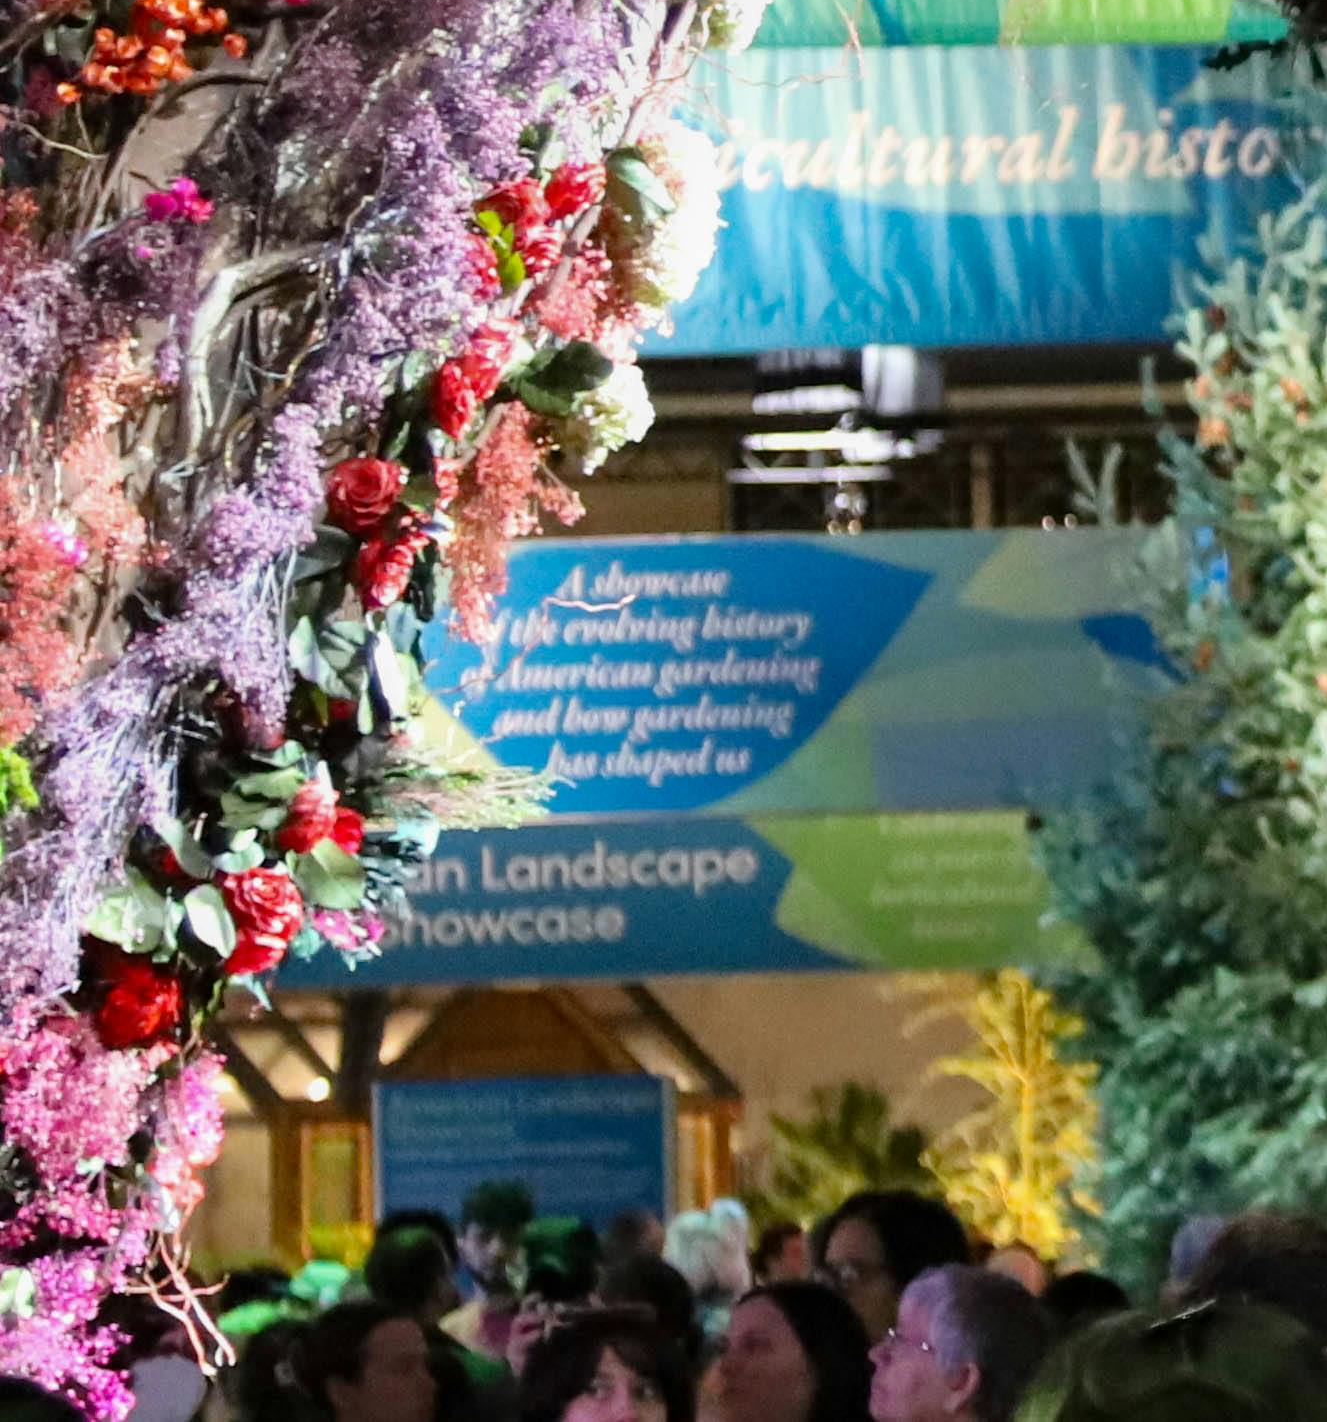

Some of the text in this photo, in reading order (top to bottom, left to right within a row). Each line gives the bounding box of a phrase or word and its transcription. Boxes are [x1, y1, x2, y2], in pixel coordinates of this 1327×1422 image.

[552, 560, 731, 600] A showcase
[563, 605, 696, 654] evolving
[701, 603, 814, 651] history
[493, 652, 656, 691] American
[653, 646, 821, 698] gardening
[491, 692, 793, 742] and how gardening
[546, 736, 751, 788] has shaped us
[481, 840, 758, 898] Landscape
